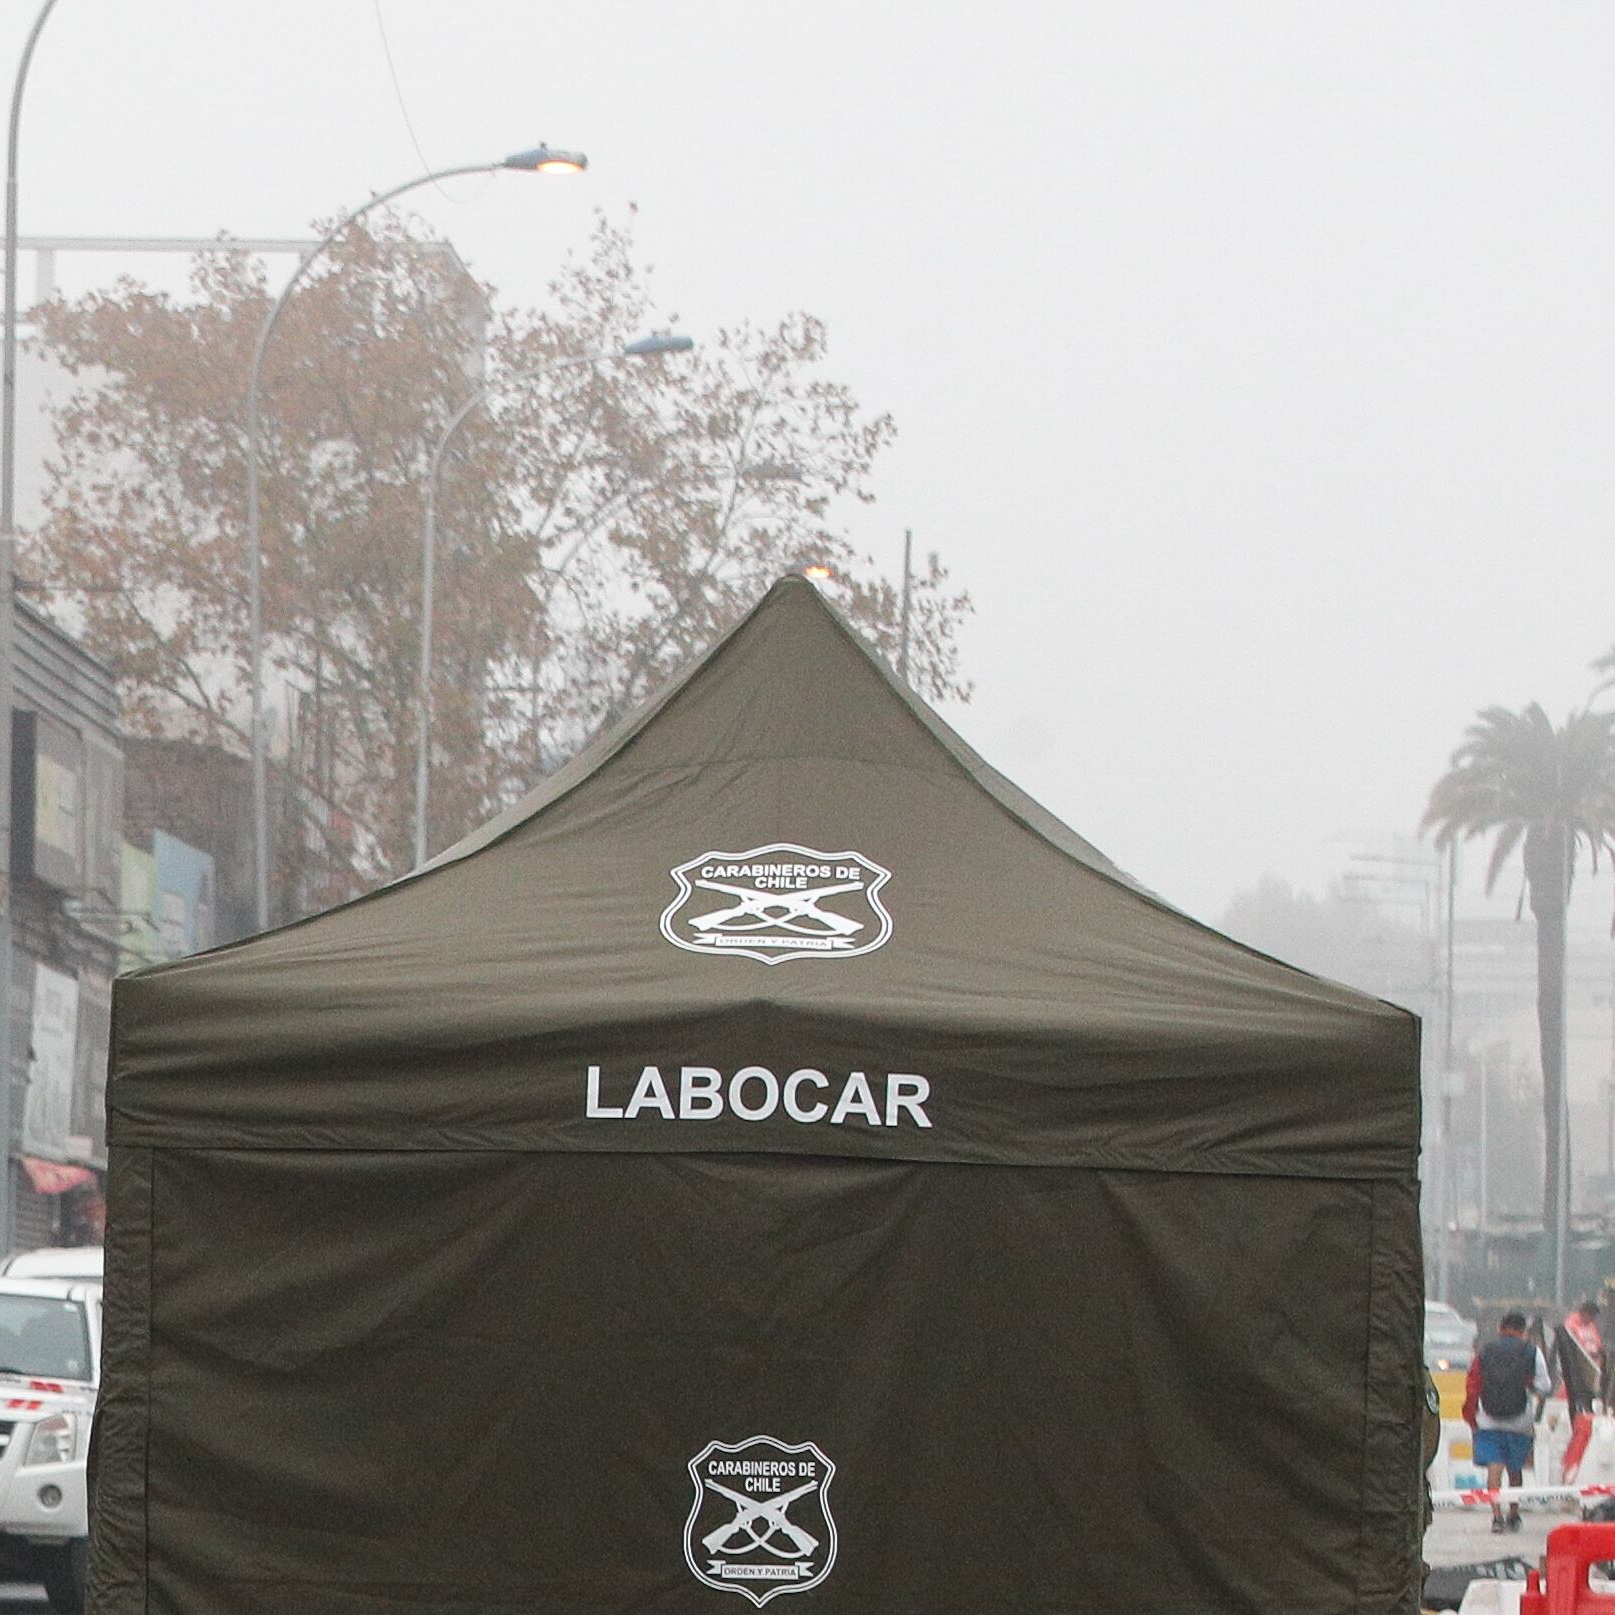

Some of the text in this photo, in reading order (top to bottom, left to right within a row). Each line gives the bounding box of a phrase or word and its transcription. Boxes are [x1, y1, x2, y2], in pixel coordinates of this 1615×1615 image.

[701, 863, 861, 880] CARABINEROS DE
[754, 876, 808, 889] CHILE
[719, 937, 828, 947] ORDEN Y PATRIA
[585, 1065, 933, 1128] LABOCAR
[708, 1460, 816, 1477] CARABINEROS DE
[744, 1477, 781, 1492] CHILE
[723, 1567, 755, 1576] ORDEN
[765, 1568, 797, 1578] PATRIA
